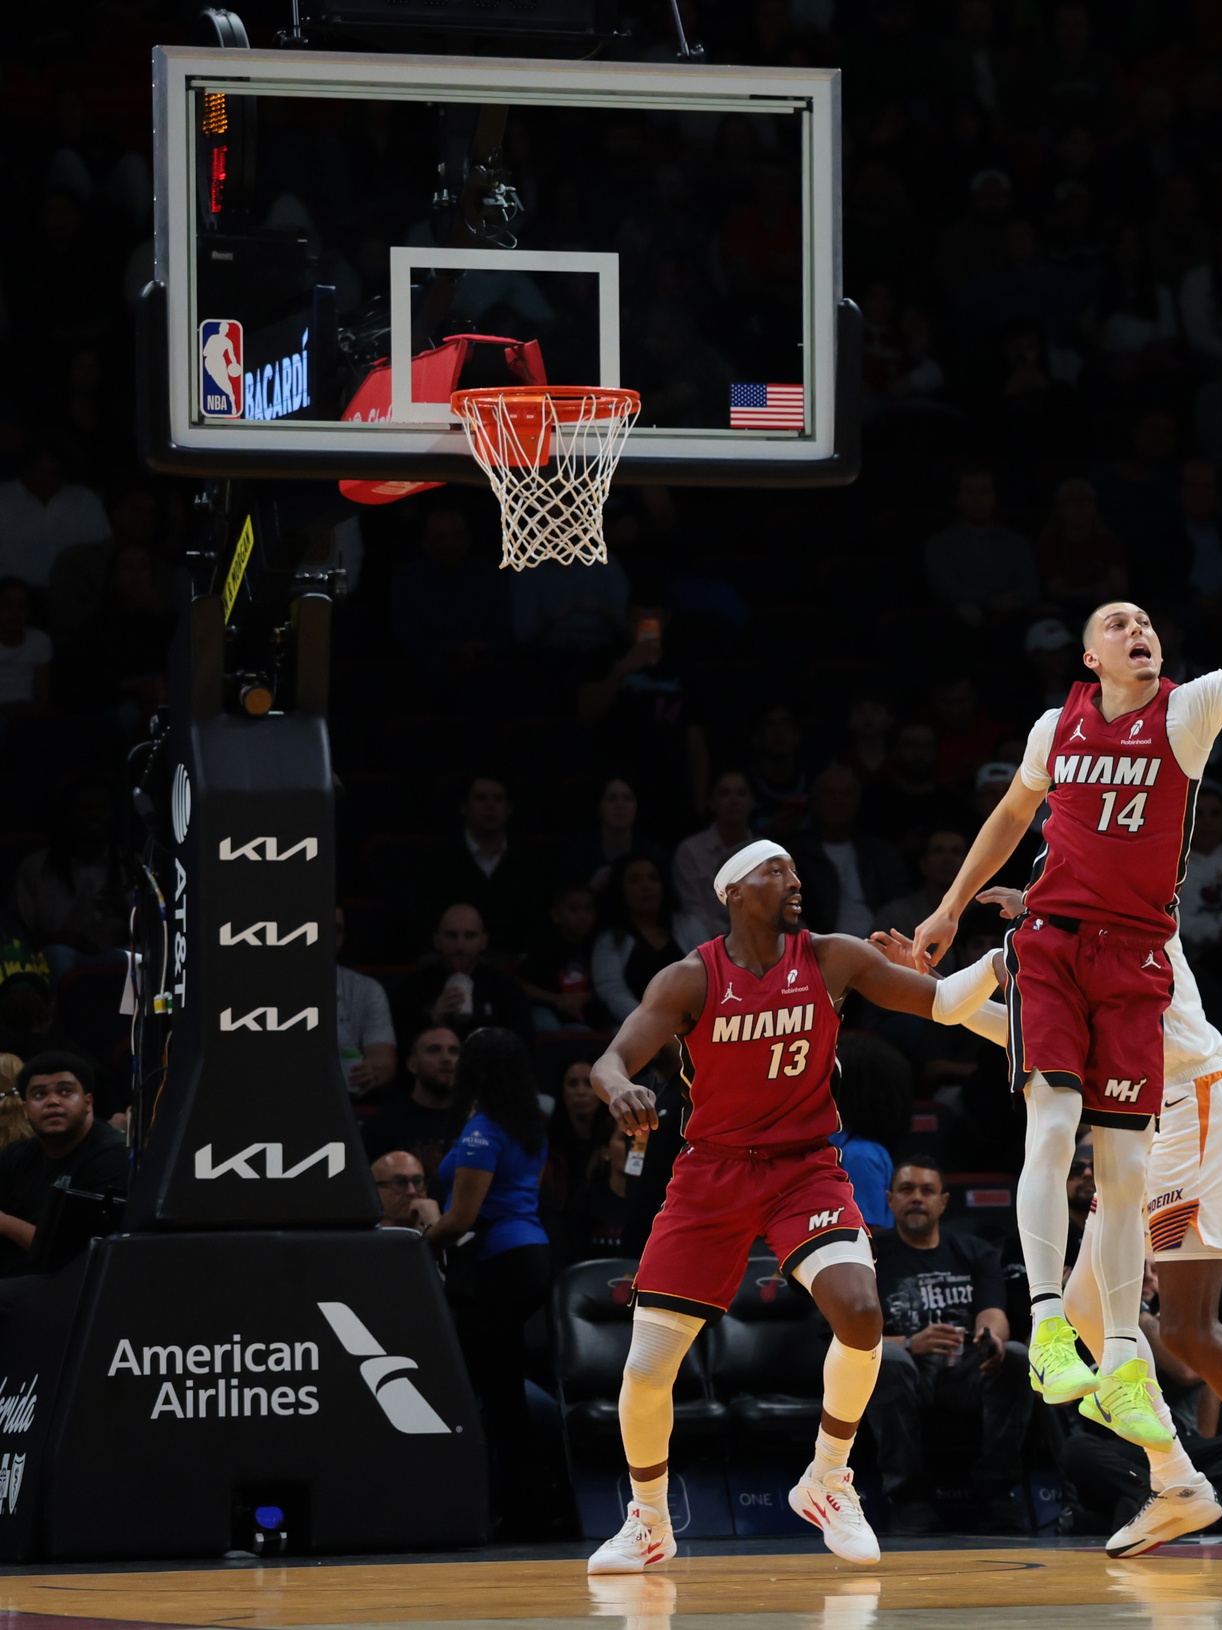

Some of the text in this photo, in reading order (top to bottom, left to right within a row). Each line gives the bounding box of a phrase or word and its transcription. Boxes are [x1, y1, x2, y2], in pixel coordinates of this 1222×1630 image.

[206, 394, 229, 411] NBA
[1120, 738, 1152, 746] Robinhood
[1053, 754, 1162, 787] MIAMI
[1097, 791, 1149, 833] 14
[219, 836, 318, 862] KIA
[174, 857, 187, 1008] AT&T
[219, 921, 319, 946] KIA
[780, 985, 809, 995] Robinhood
[219, 1006, 319, 1032] KIA
[711, 1003, 815, 1043] MIAMI
[767, 1038, 811, 1080] 13
[194, 1141, 346, 1180] KIA
[107, 1334, 320, 1377] American
[150, 1378, 320, 1420] Airlines
[739, 1492, 774, 1507] ONE
